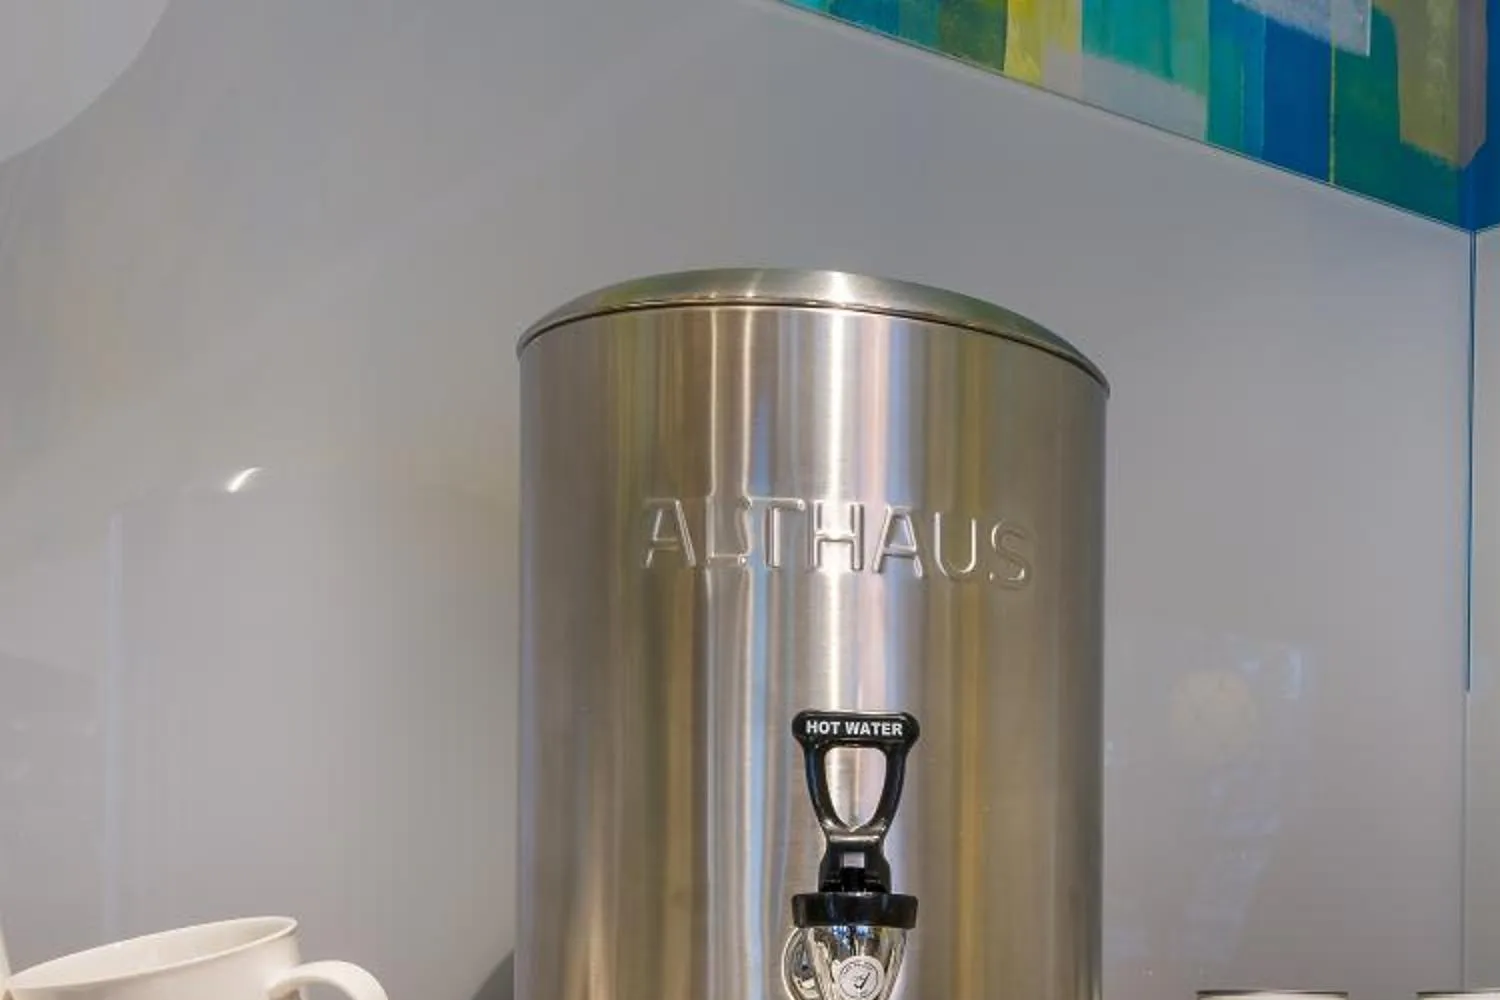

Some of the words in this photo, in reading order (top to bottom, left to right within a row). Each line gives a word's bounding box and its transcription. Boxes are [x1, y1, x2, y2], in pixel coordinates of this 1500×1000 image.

[641, 496, 1037, 588] ALTHAUS
[805, 720, 841, 735] HOT
[845, 721, 903, 736] WATER
